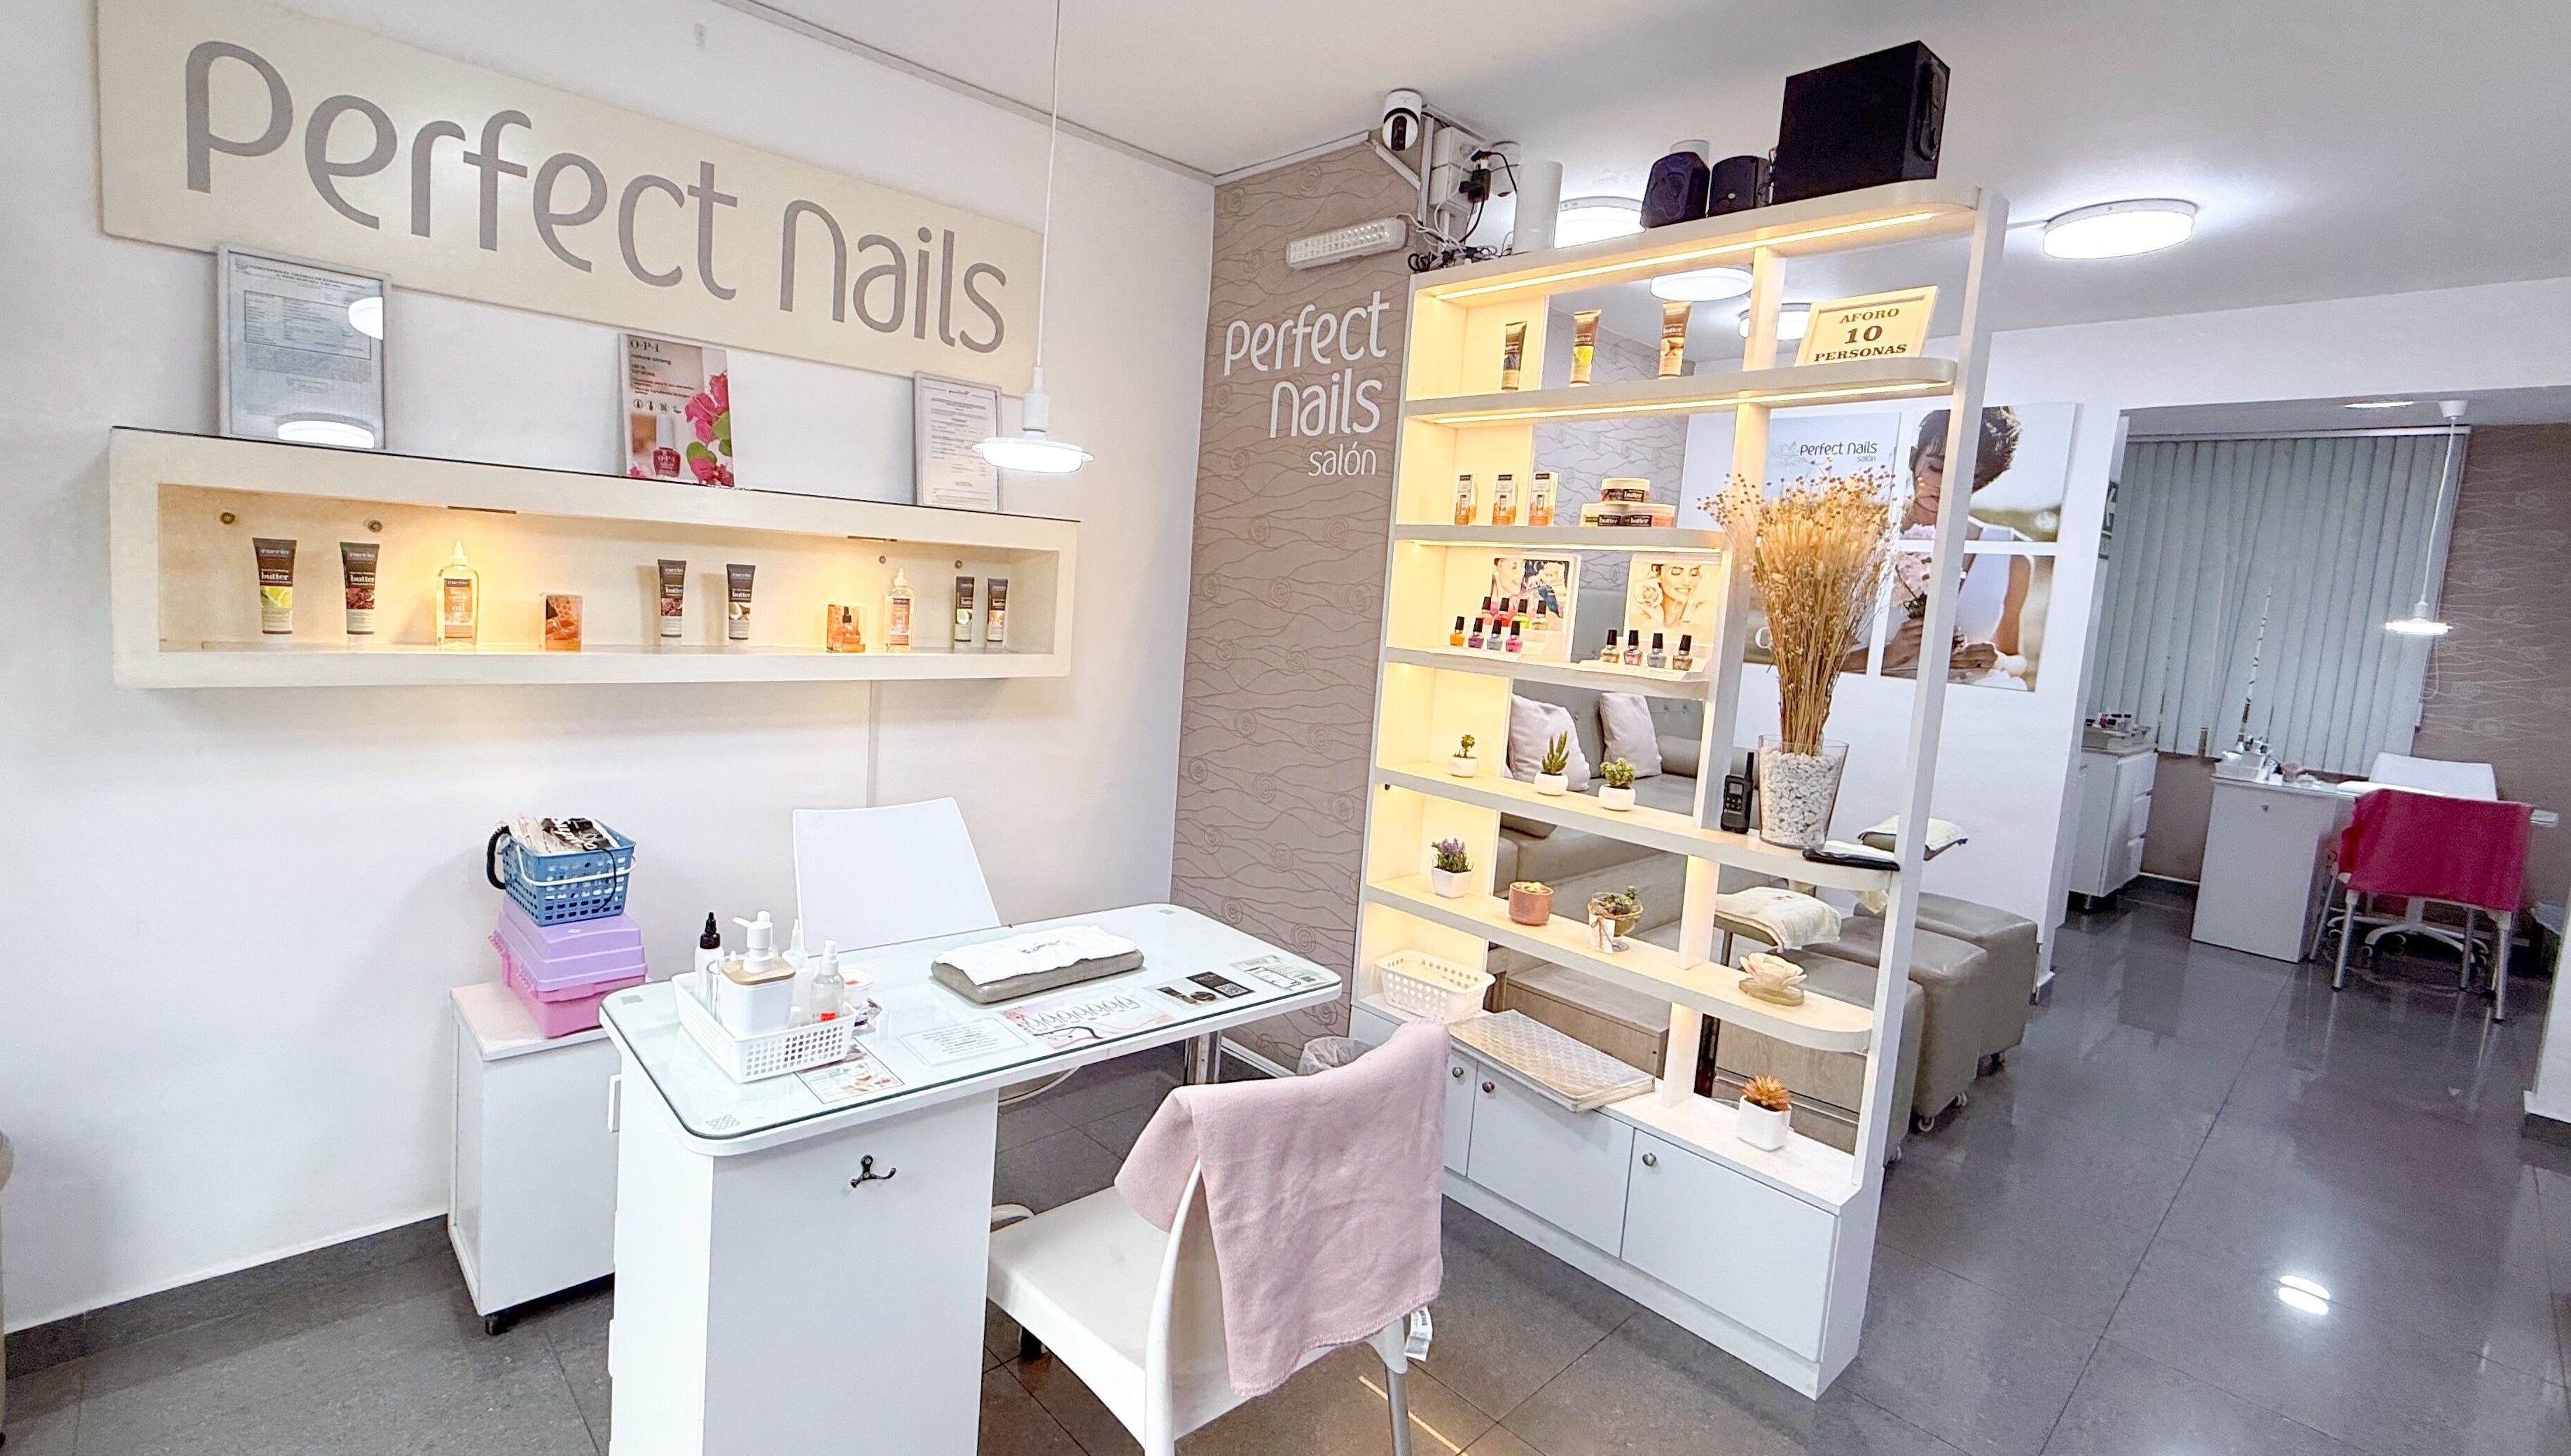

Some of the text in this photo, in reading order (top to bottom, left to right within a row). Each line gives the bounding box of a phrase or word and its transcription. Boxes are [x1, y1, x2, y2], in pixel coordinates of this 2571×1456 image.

[1839, 308, 1899, 324] AFORO
[1845, 326, 1883, 344] 10
[1814, 344, 1907, 361] PERSONAS
[1308, 441, 1377, 476] salón
[261, 572, 289, 581] butter
[350, 574, 375, 583] butter
